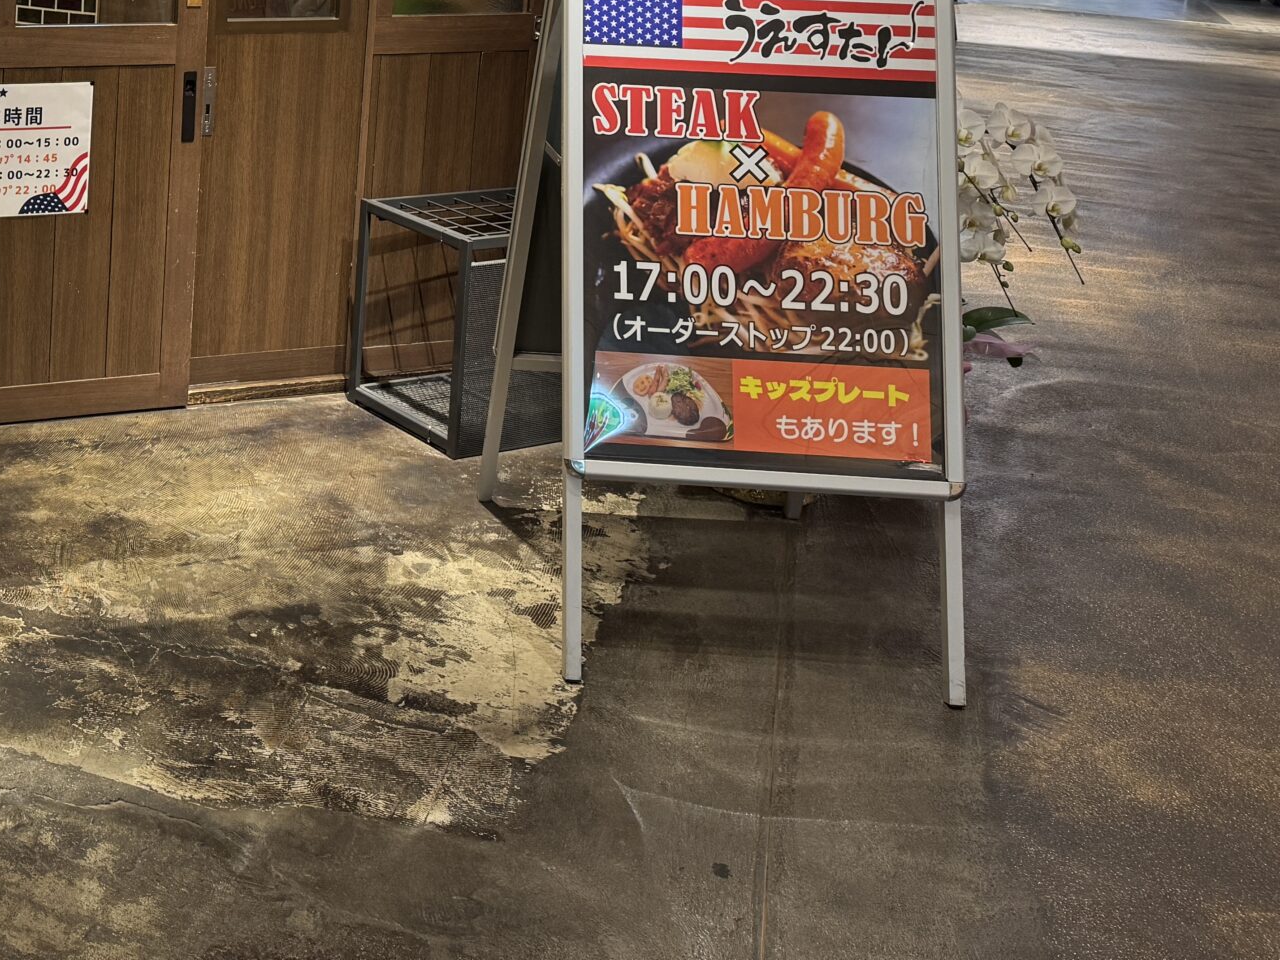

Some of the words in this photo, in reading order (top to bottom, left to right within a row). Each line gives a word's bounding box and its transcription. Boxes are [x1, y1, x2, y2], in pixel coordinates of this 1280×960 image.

[591, 82, 764, 142] STEAK
[674, 181, 929, 248] HAMBURG
[739, 375, 910, 407] キッズプレート
